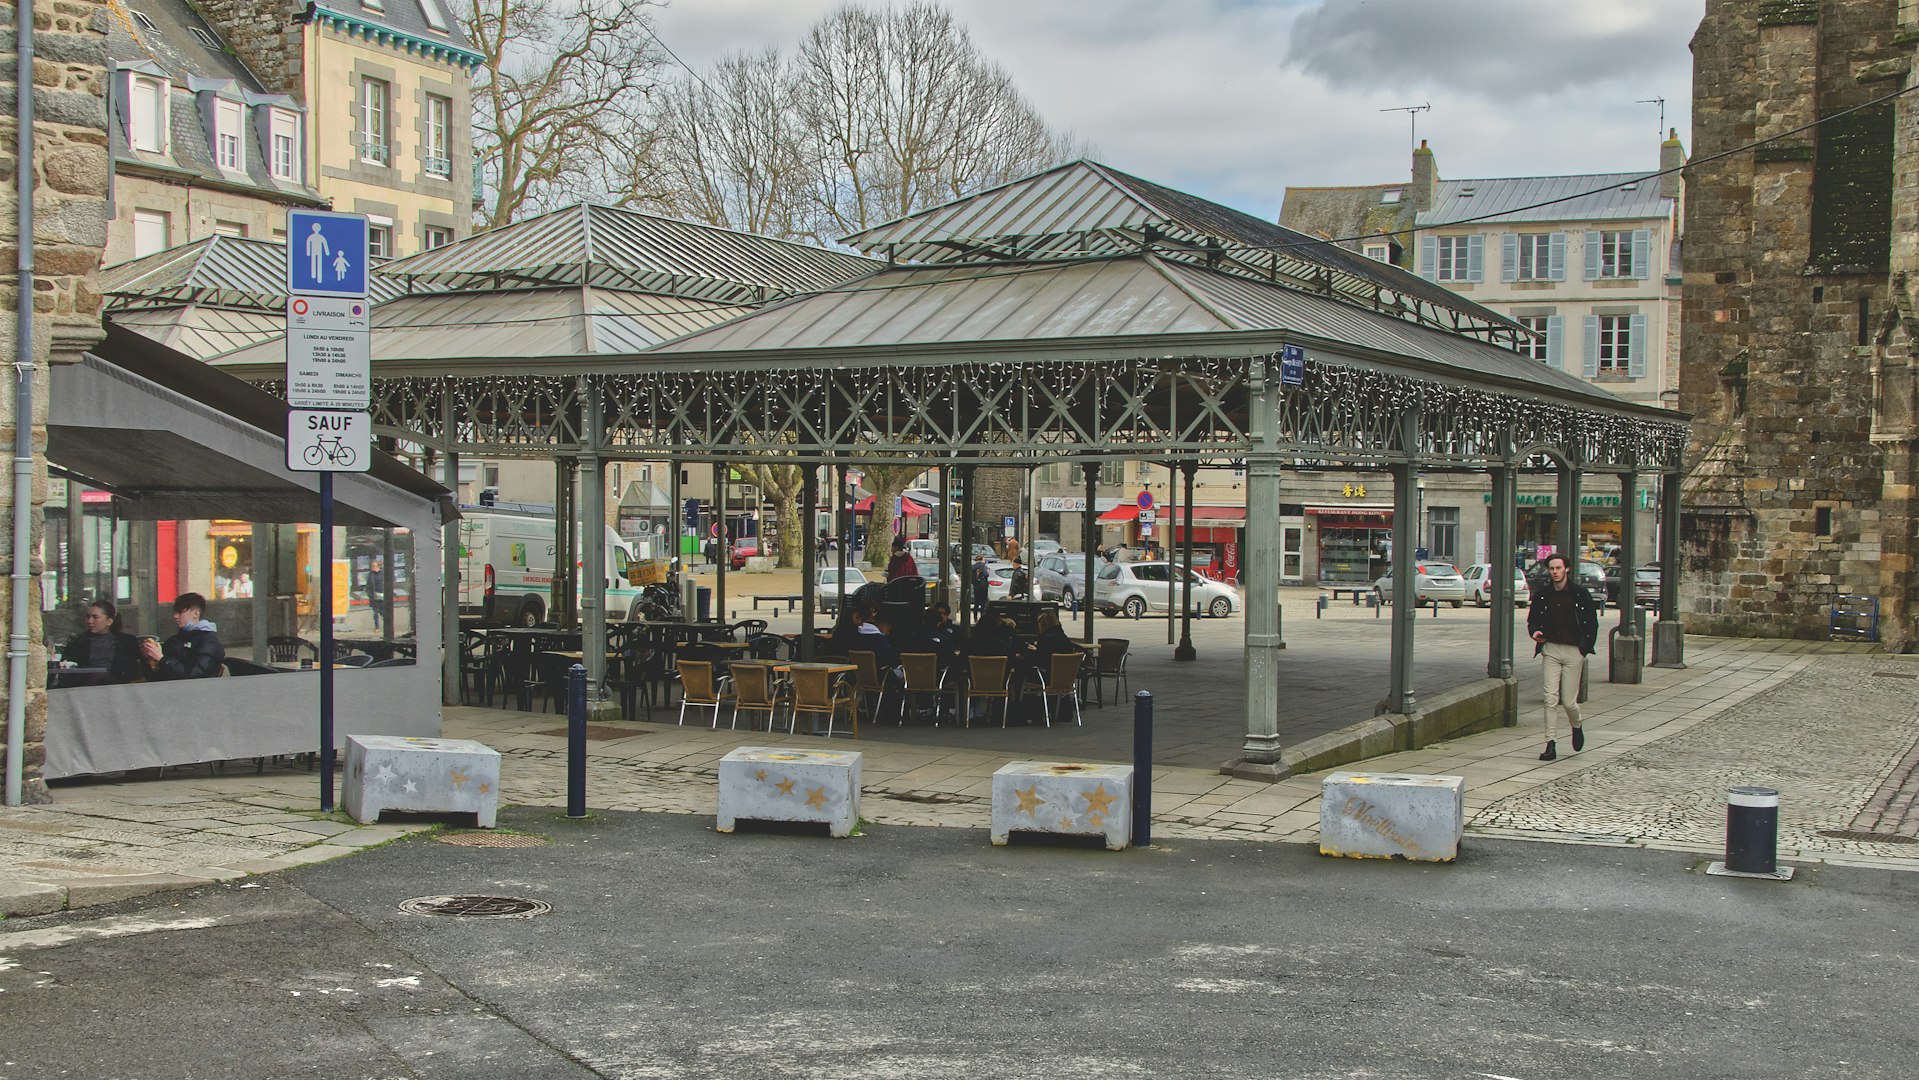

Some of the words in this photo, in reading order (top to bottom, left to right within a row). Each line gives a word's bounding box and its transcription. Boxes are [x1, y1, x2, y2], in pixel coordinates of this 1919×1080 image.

[308, 415, 353, 431] SAUF
[1341, 483, 1366, 498] 香港
[1484, 495, 1552, 505] PMACIE
